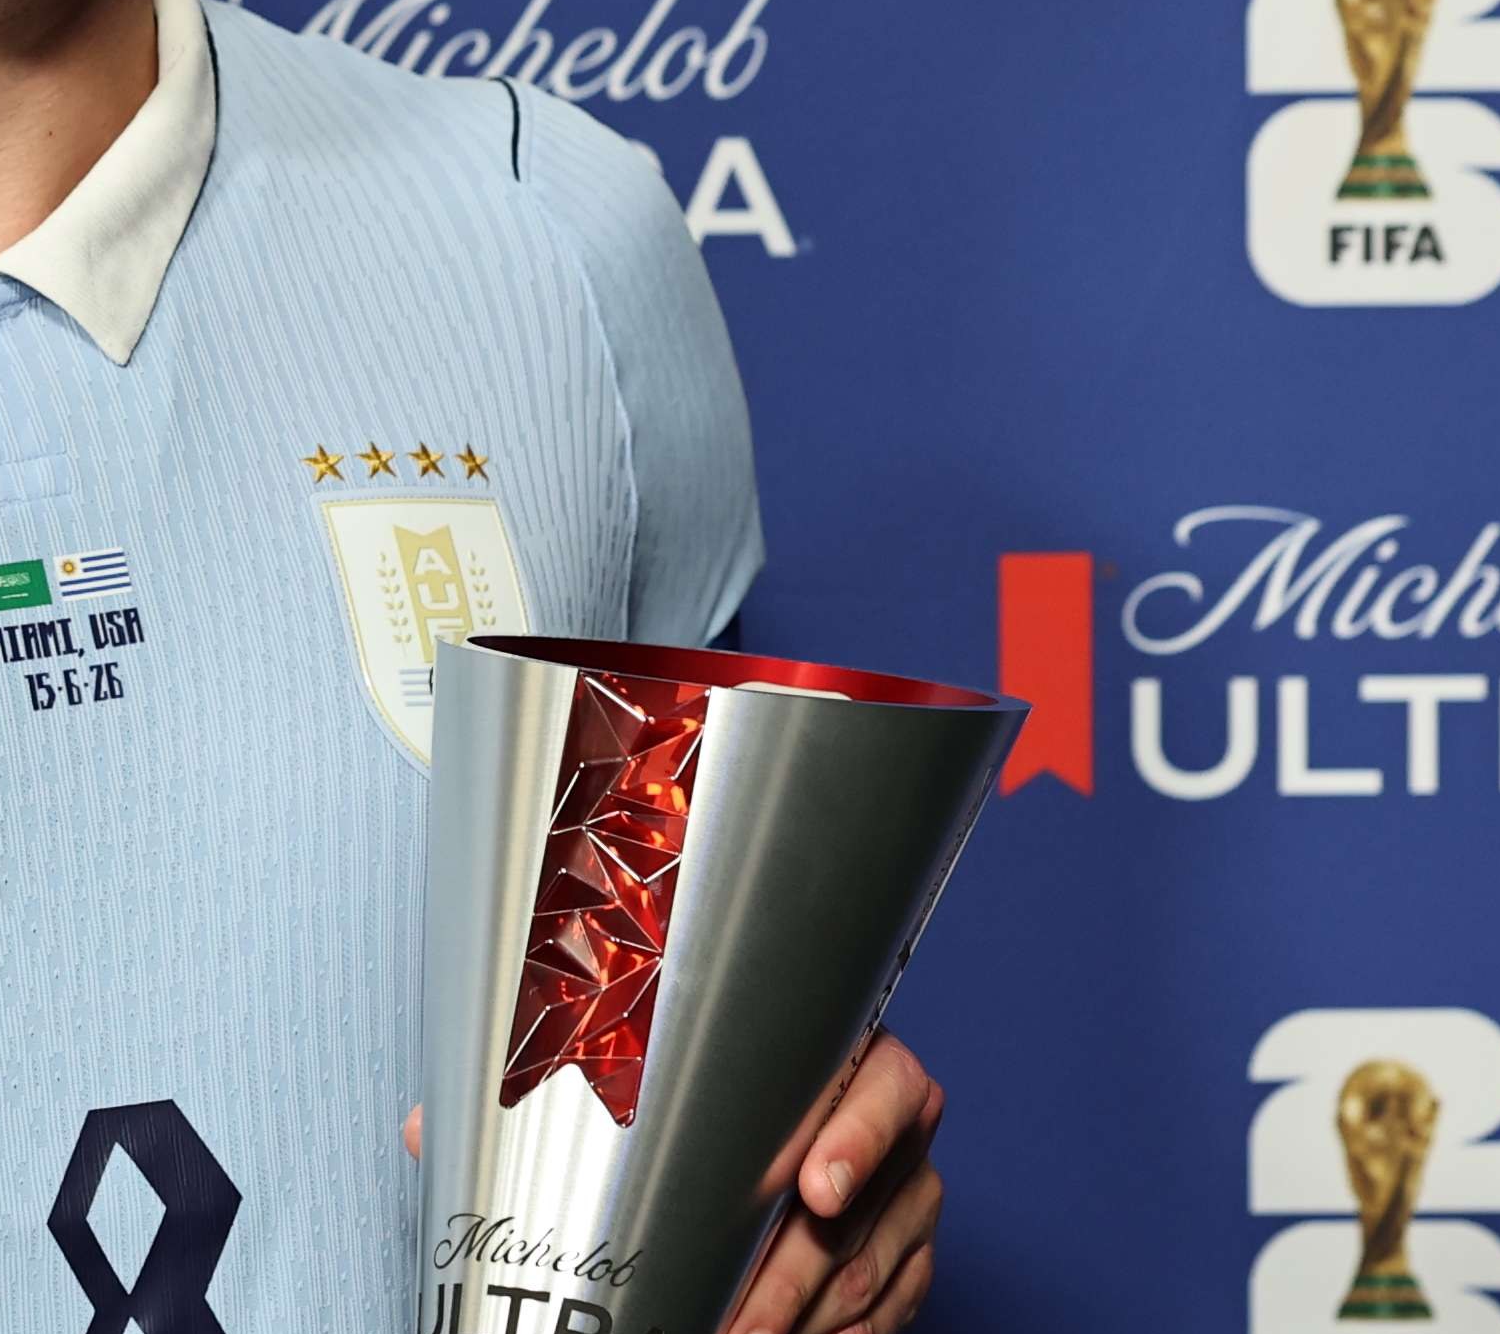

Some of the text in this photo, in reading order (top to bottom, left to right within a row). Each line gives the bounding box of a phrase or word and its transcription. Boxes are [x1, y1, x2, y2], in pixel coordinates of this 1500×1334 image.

[1328, 224, 1444, 264] FIFA
[87, 606, 145, 650] USA
[432, 1212, 644, 1288] Michelob
